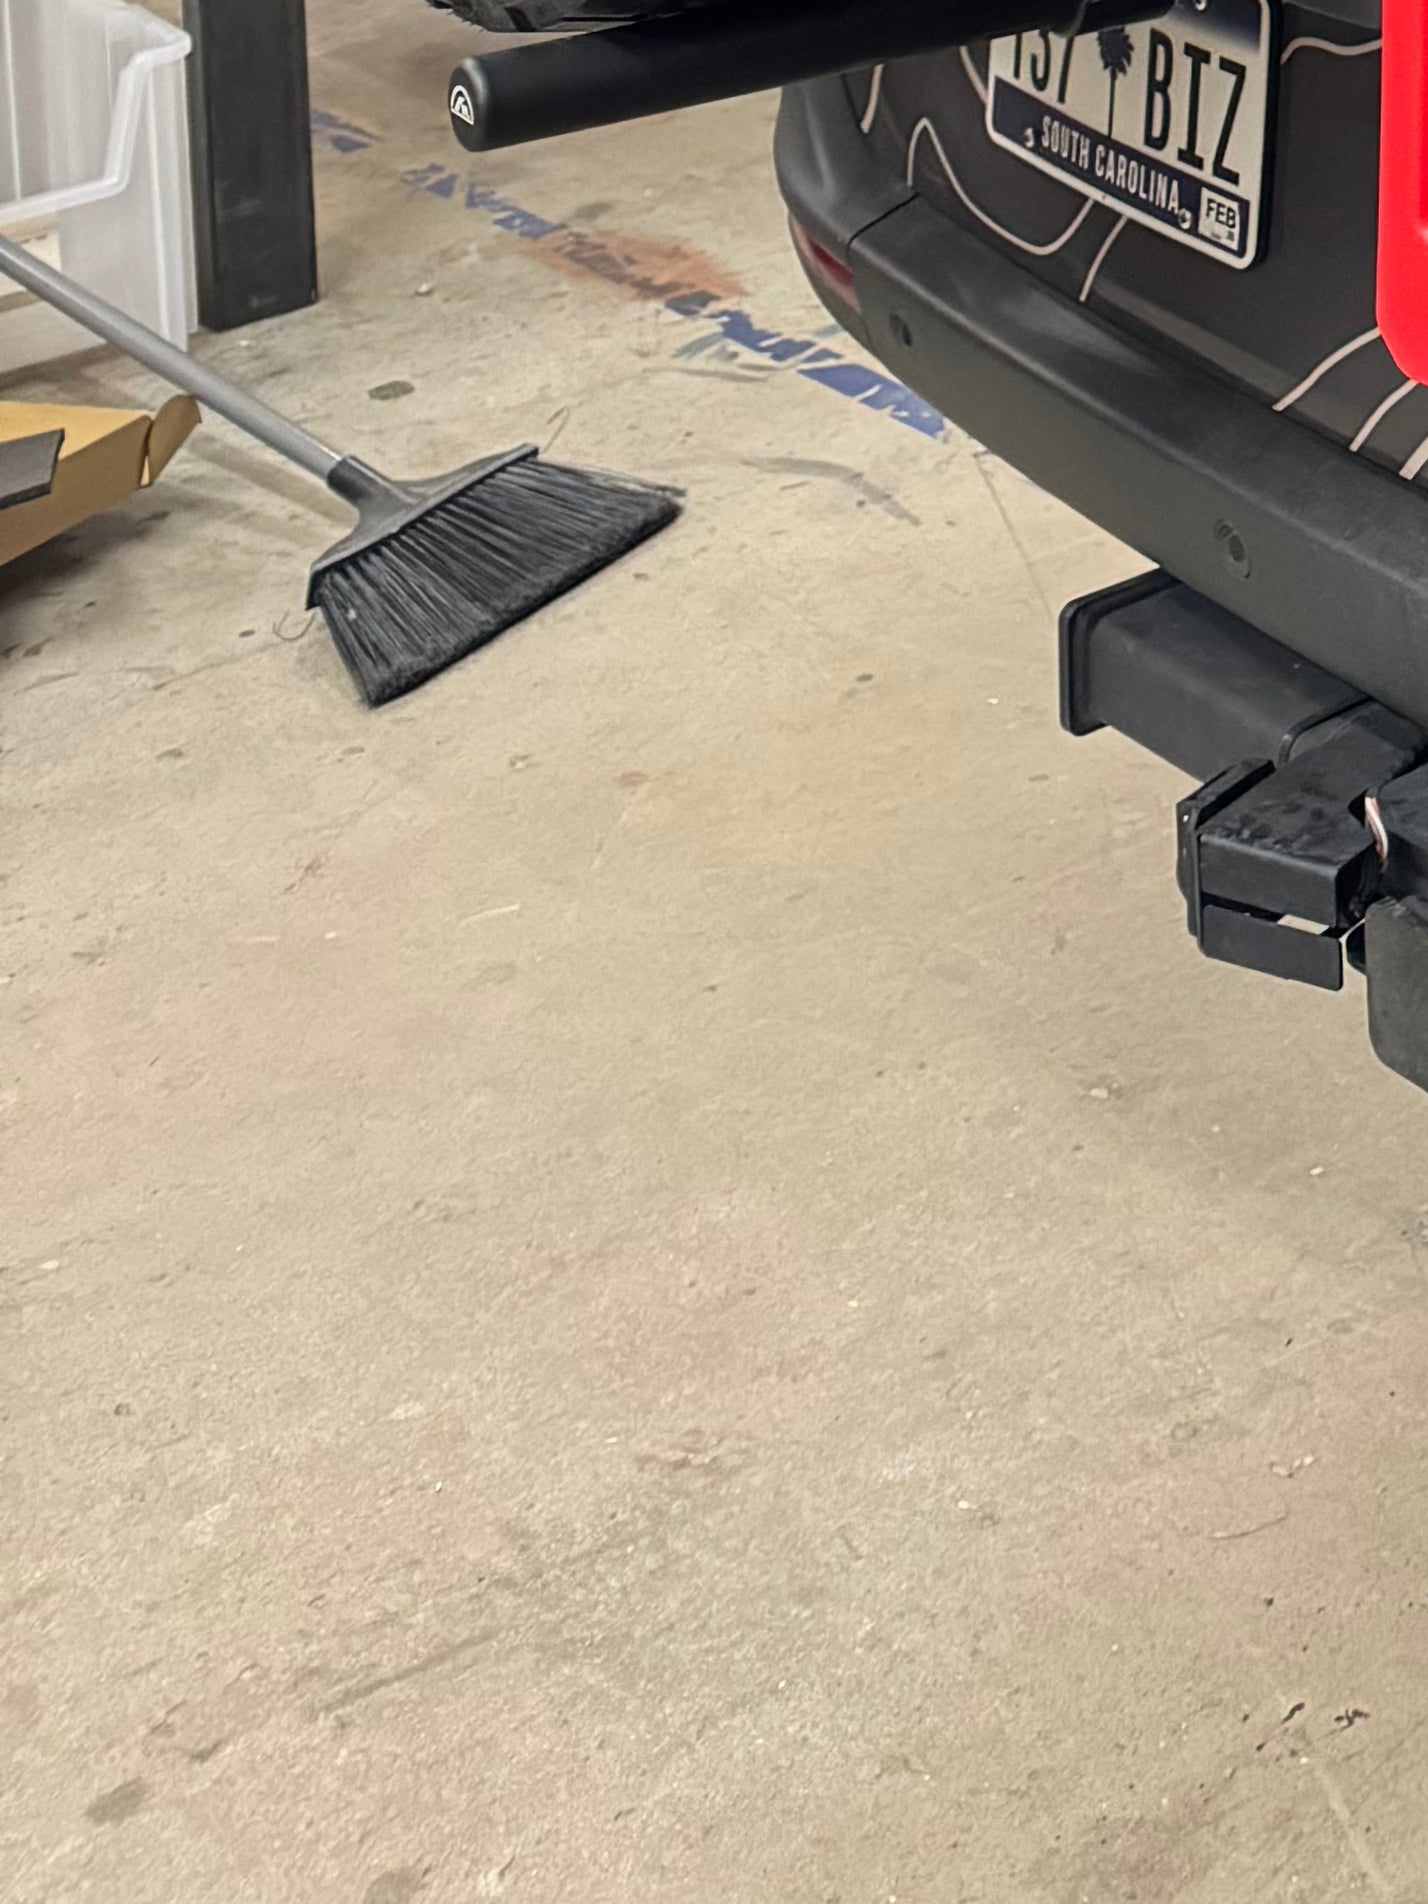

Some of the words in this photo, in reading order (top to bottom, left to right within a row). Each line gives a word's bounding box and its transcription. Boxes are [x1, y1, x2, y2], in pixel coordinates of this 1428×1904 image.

[1145, 28, 1247, 186] BIZ
[1041, 114, 1089, 170] SOUTH
[1095, 144, 1179, 215] CAROLINA
[1206, 198, 1236, 229] FEB
